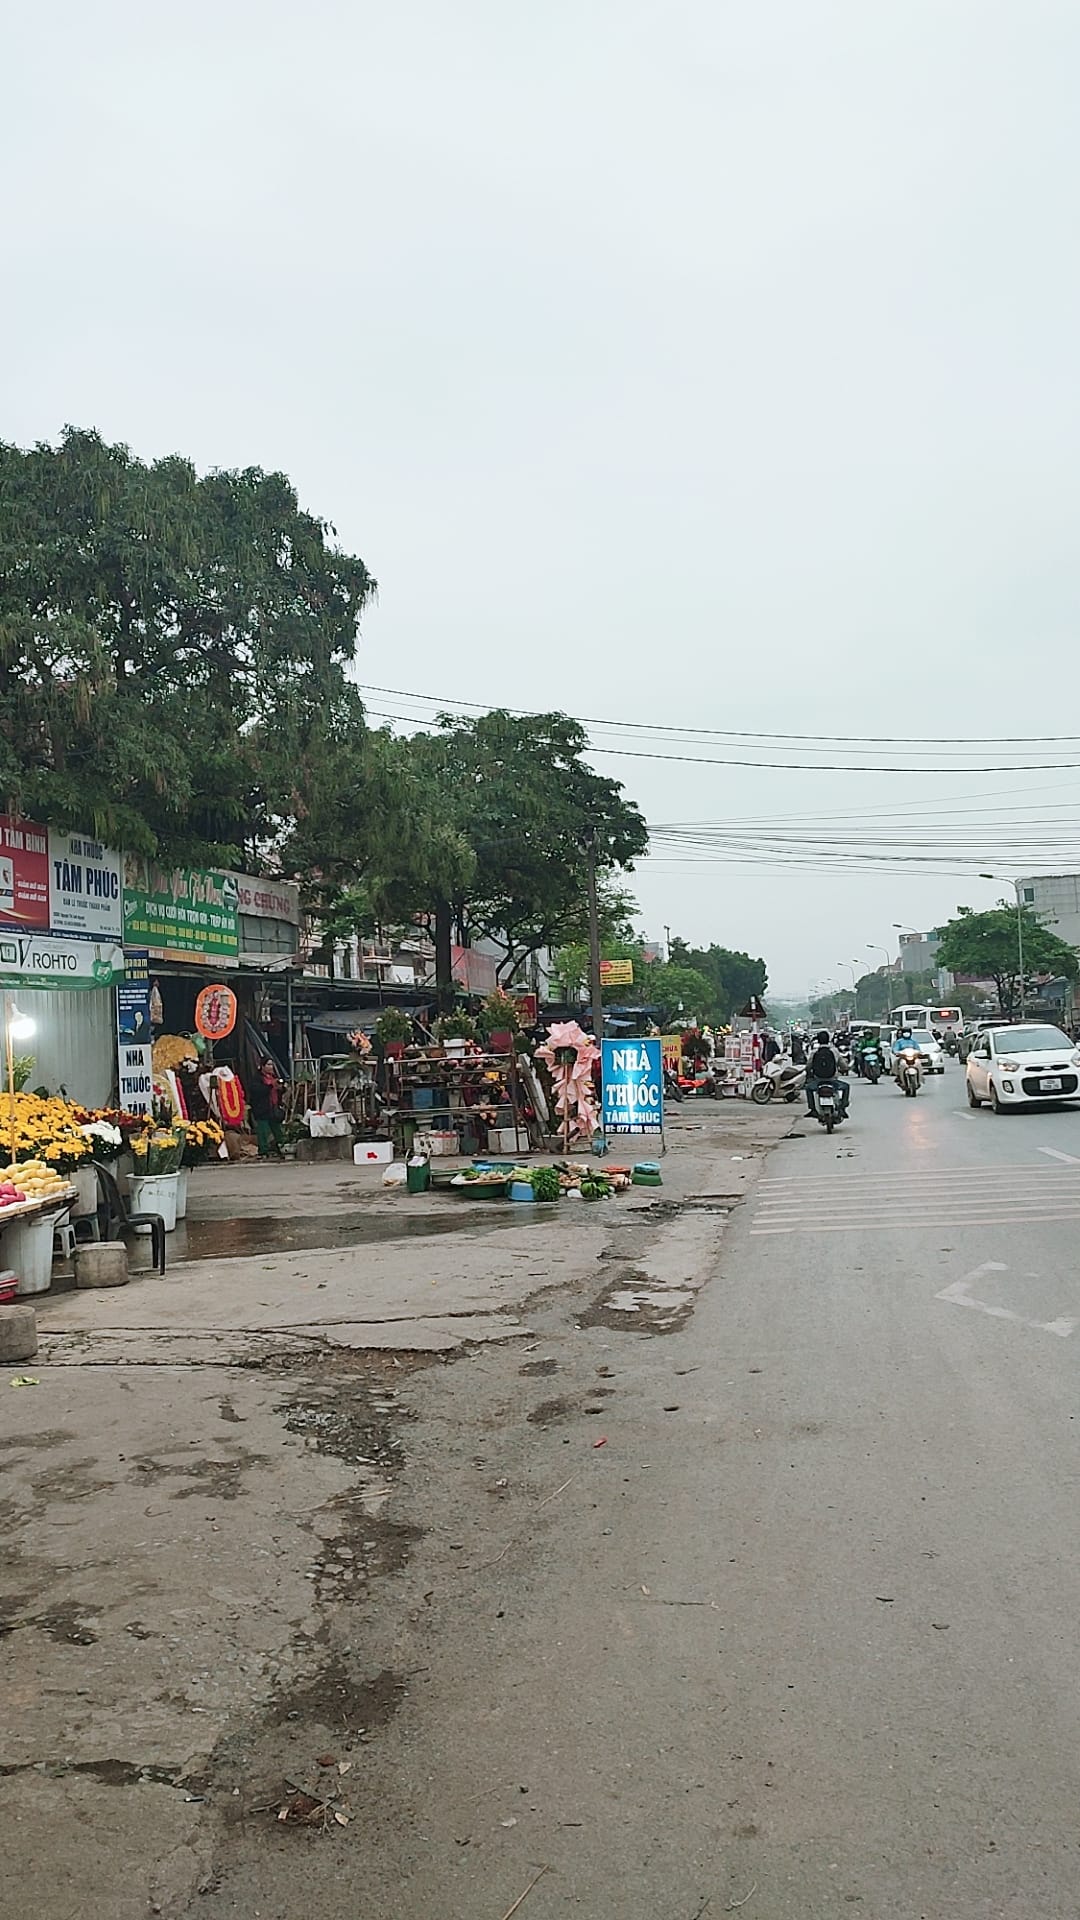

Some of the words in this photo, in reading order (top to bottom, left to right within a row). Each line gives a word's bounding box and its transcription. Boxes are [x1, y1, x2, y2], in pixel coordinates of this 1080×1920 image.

[54, 858, 82, 894] TÂM
[86, 866, 119, 900] PHÚC
[126, 1047, 145, 1067] NHÀ
[612, 1043, 652, 1072] NHÀ
[121, 1070, 151, 1094] THUỐC
[606, 1073, 659, 1107] THUỐC
[605, 1109, 629, 1123] TÂM
[631, 1110, 660, 1124] PHÚC
